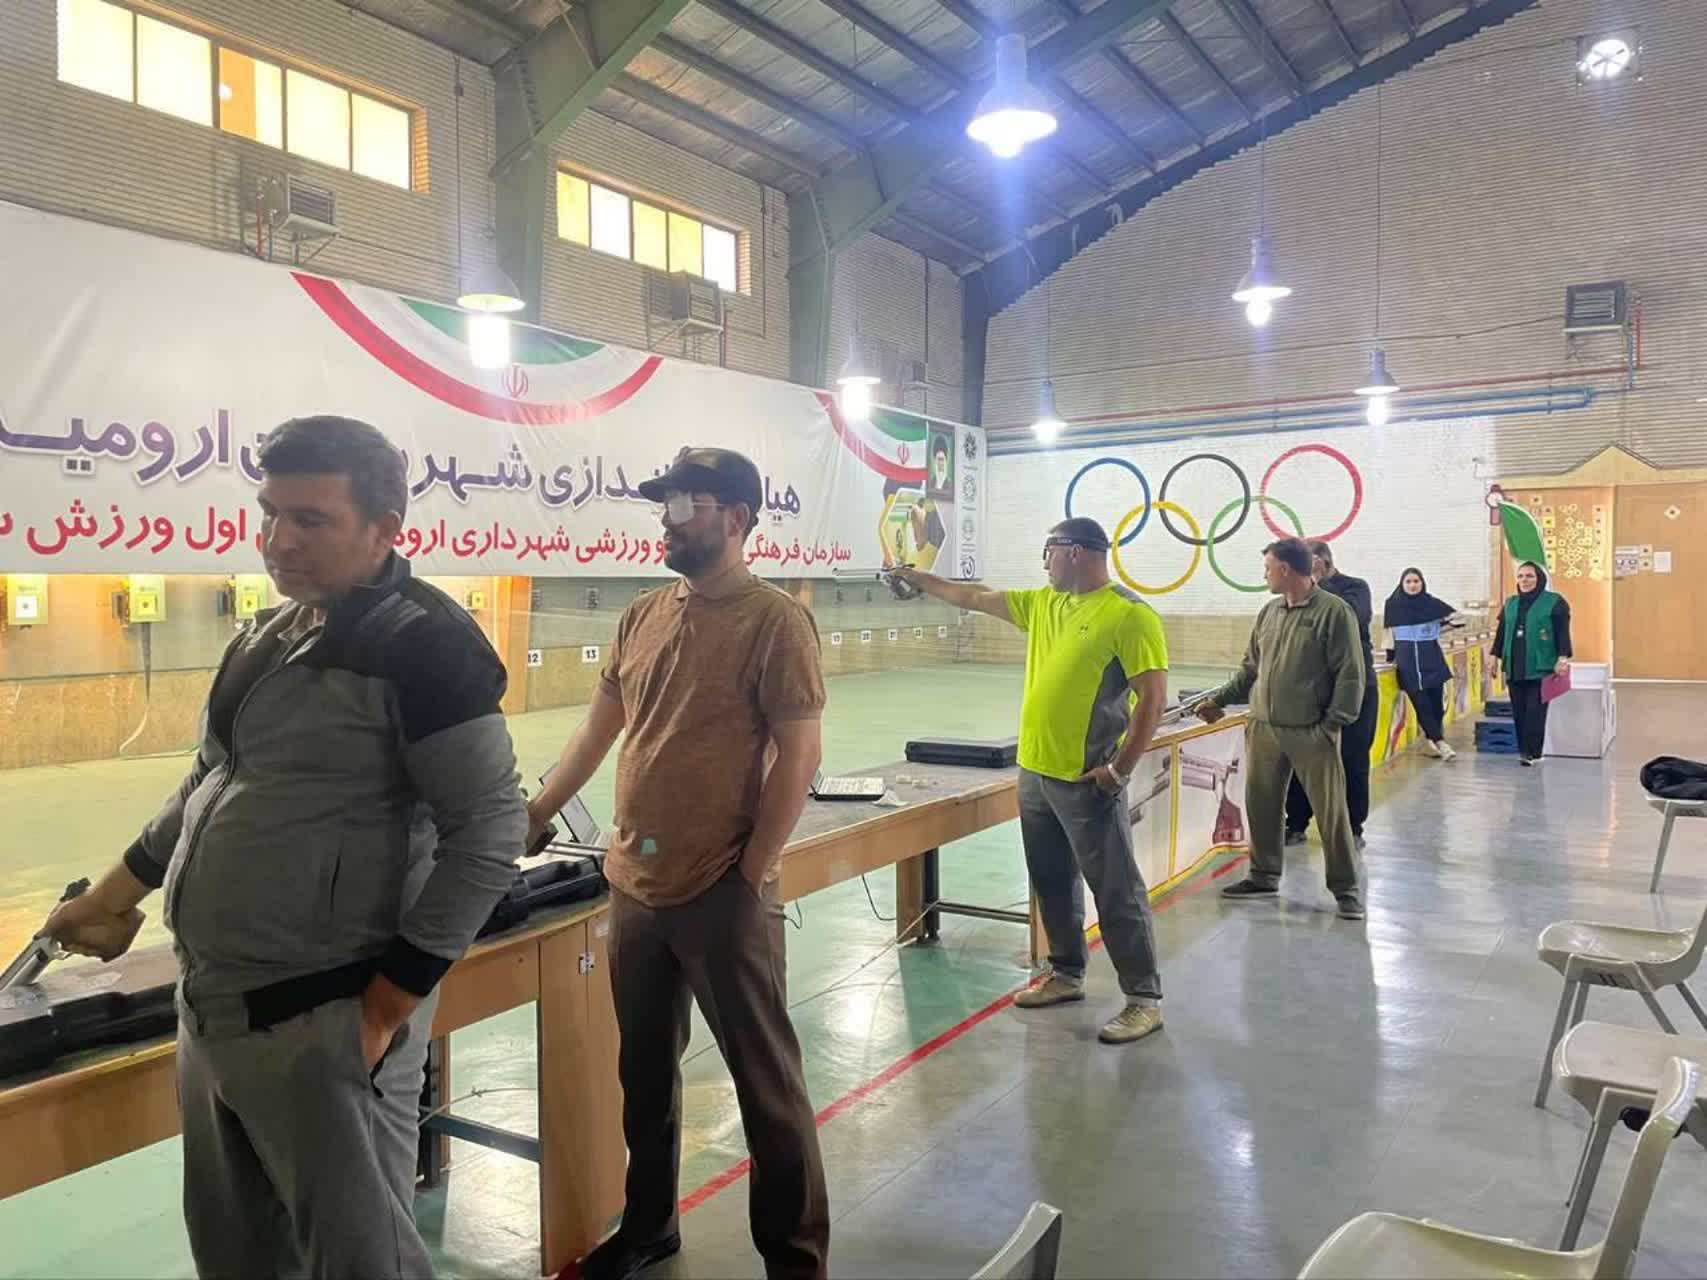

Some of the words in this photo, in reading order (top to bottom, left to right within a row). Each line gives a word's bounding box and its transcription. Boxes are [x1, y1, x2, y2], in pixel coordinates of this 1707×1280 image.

[0, 409, 229, 481] ارومی
[764, 476, 801, 521] هیا
[27, 499, 174, 555] ورزش
[185, 507, 246, 555] اول
[393, 518, 446, 559] اروم
[451, 521, 571, 561] شهرداری
[575, 527, 652, 565] ورزشی
[803, 540, 851, 566] سازمان
